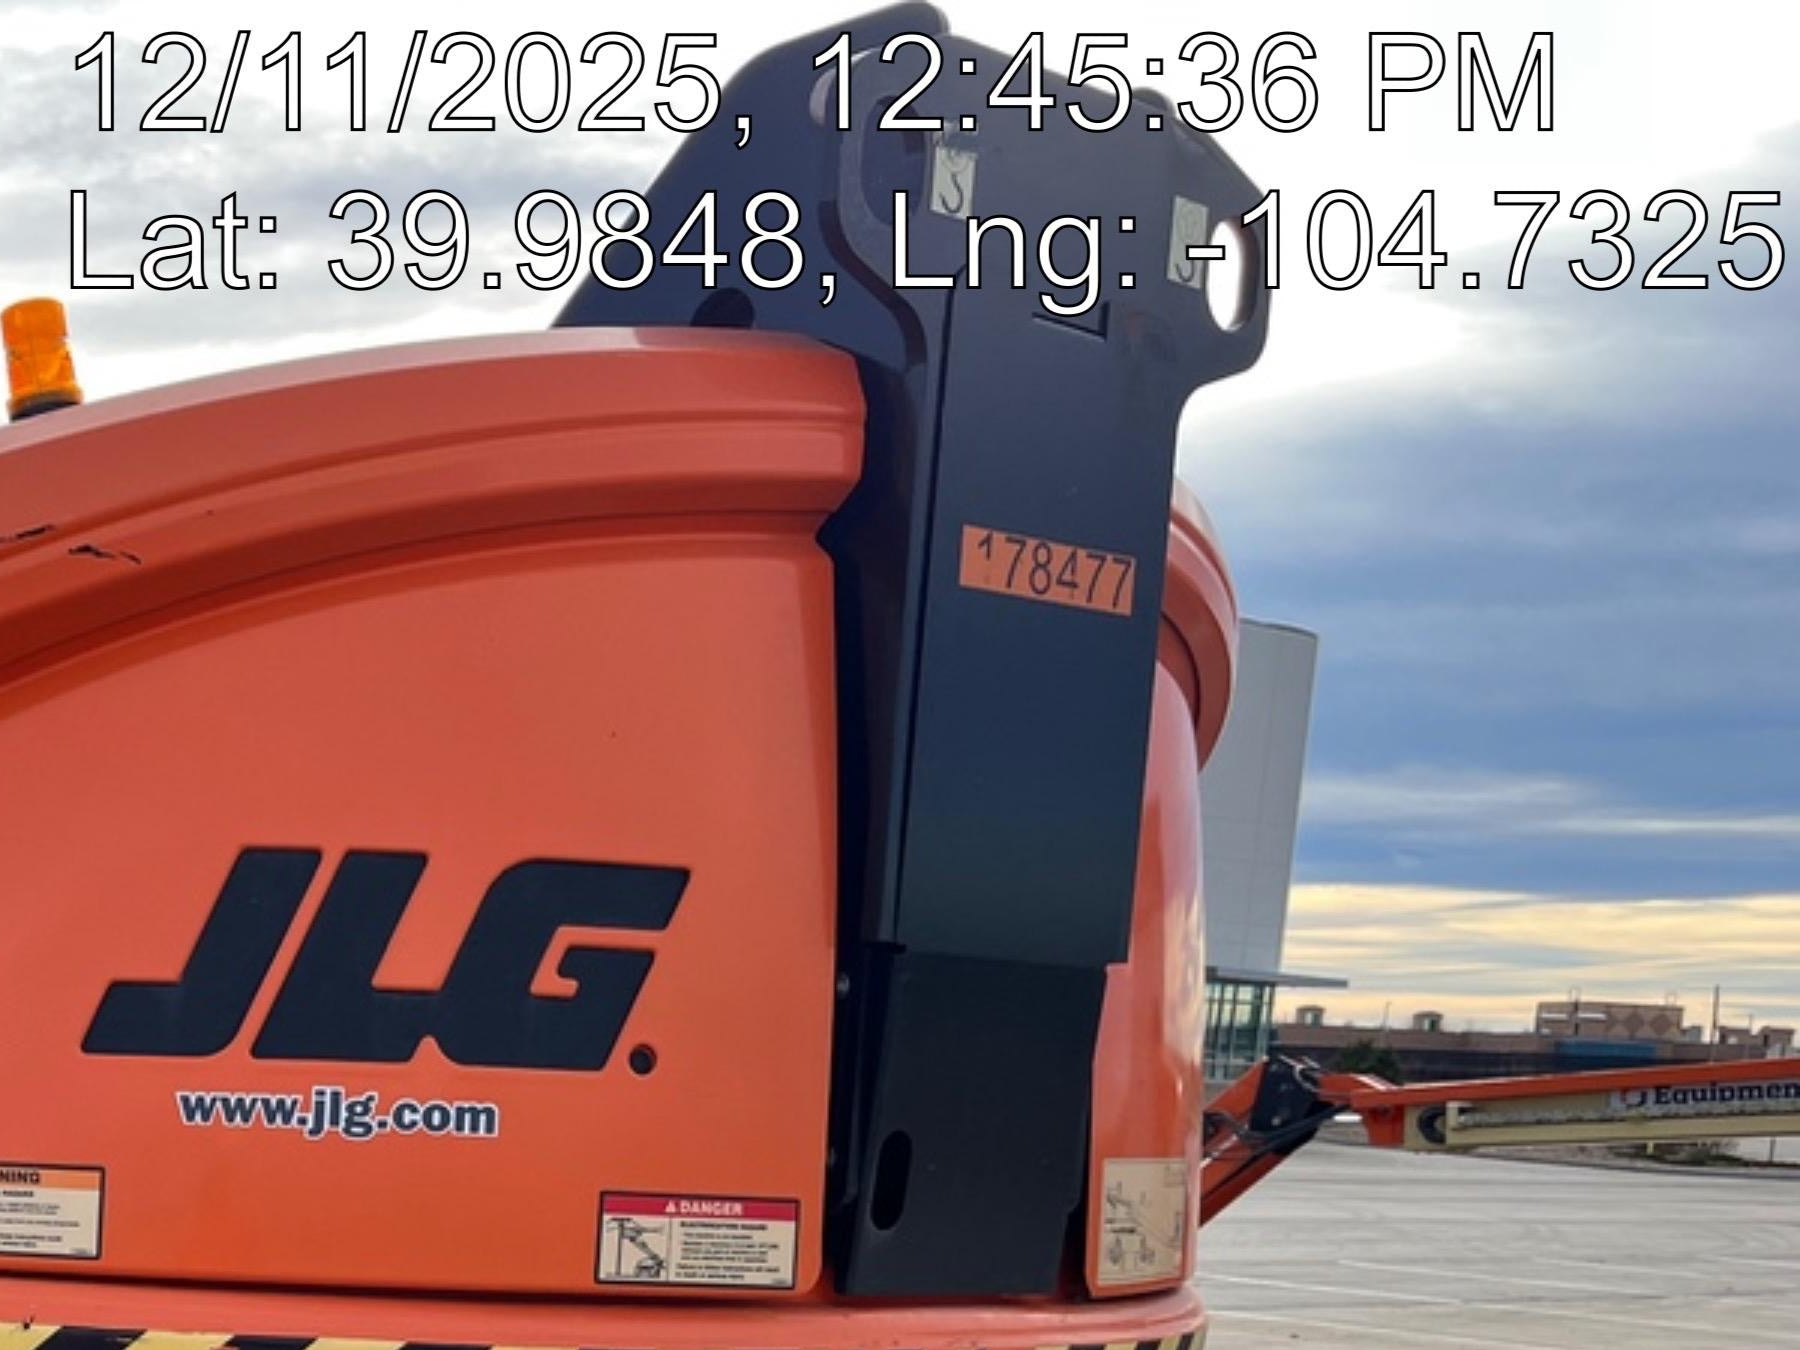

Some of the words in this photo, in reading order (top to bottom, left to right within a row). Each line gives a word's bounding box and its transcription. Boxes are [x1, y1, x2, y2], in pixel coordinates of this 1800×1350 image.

[977, 529, 1133, 609] 178477
[176, 1087, 499, 1139] www.jlg.com
[679, 1199, 744, 1217] DANGER
